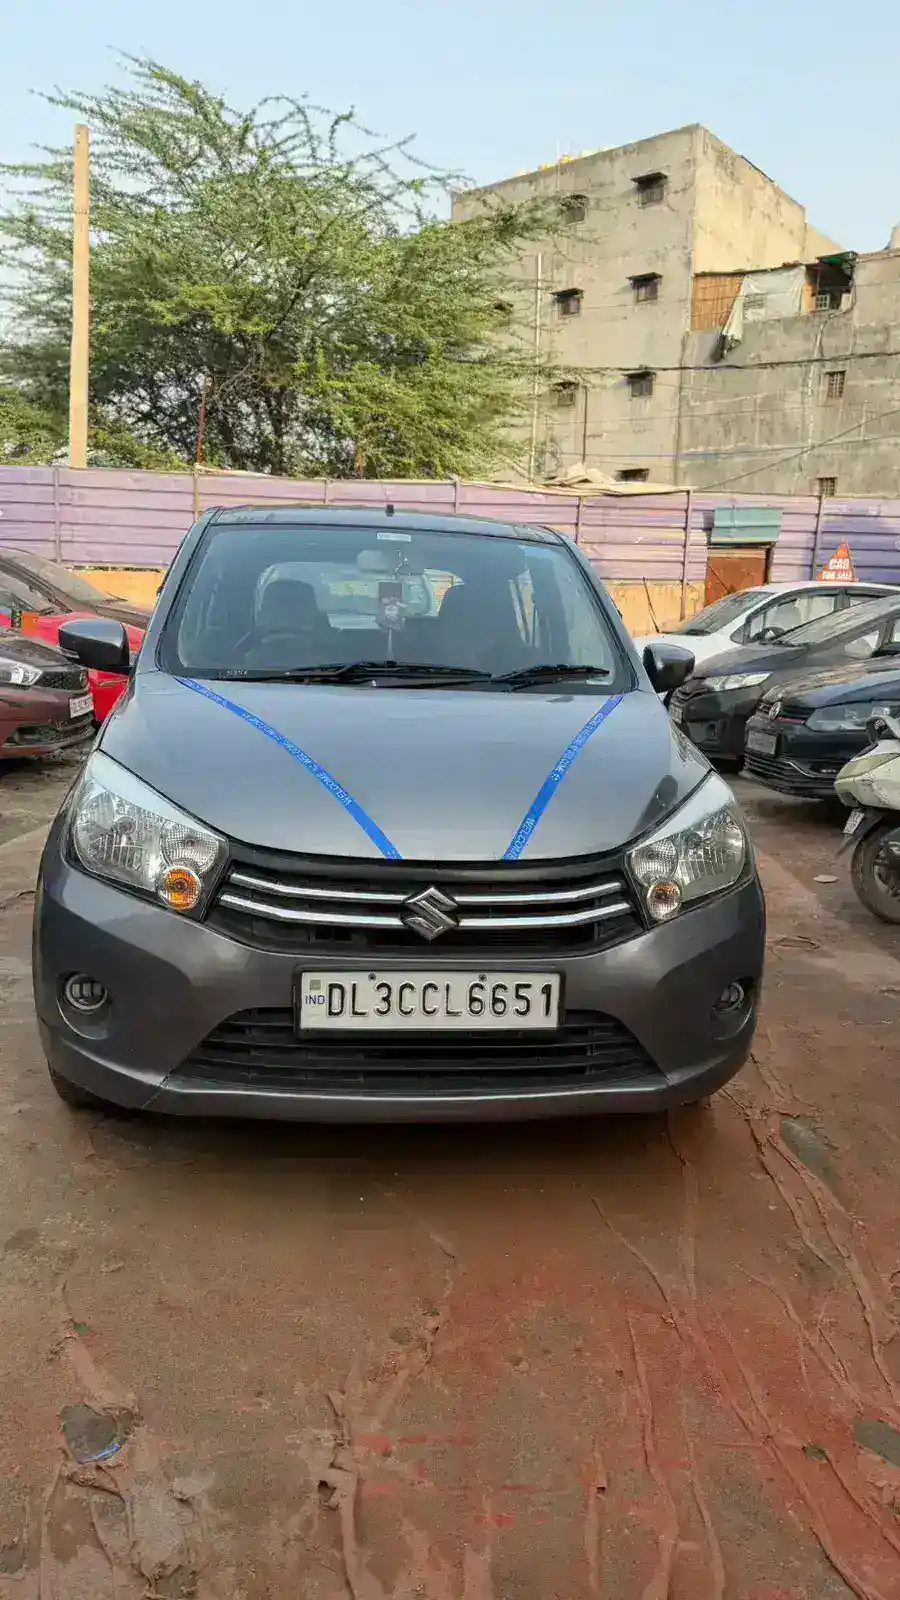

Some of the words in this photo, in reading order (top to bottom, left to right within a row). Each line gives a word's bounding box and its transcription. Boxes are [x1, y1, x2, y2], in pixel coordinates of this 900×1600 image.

[822, 570, 837, 580] FOR
[830, 558, 850, 570] CAR
[317, 770, 353, 806] WELCOME
[305, 995, 326, 1005] IND
[327, 982, 553, 1017] DL3CCL6651
